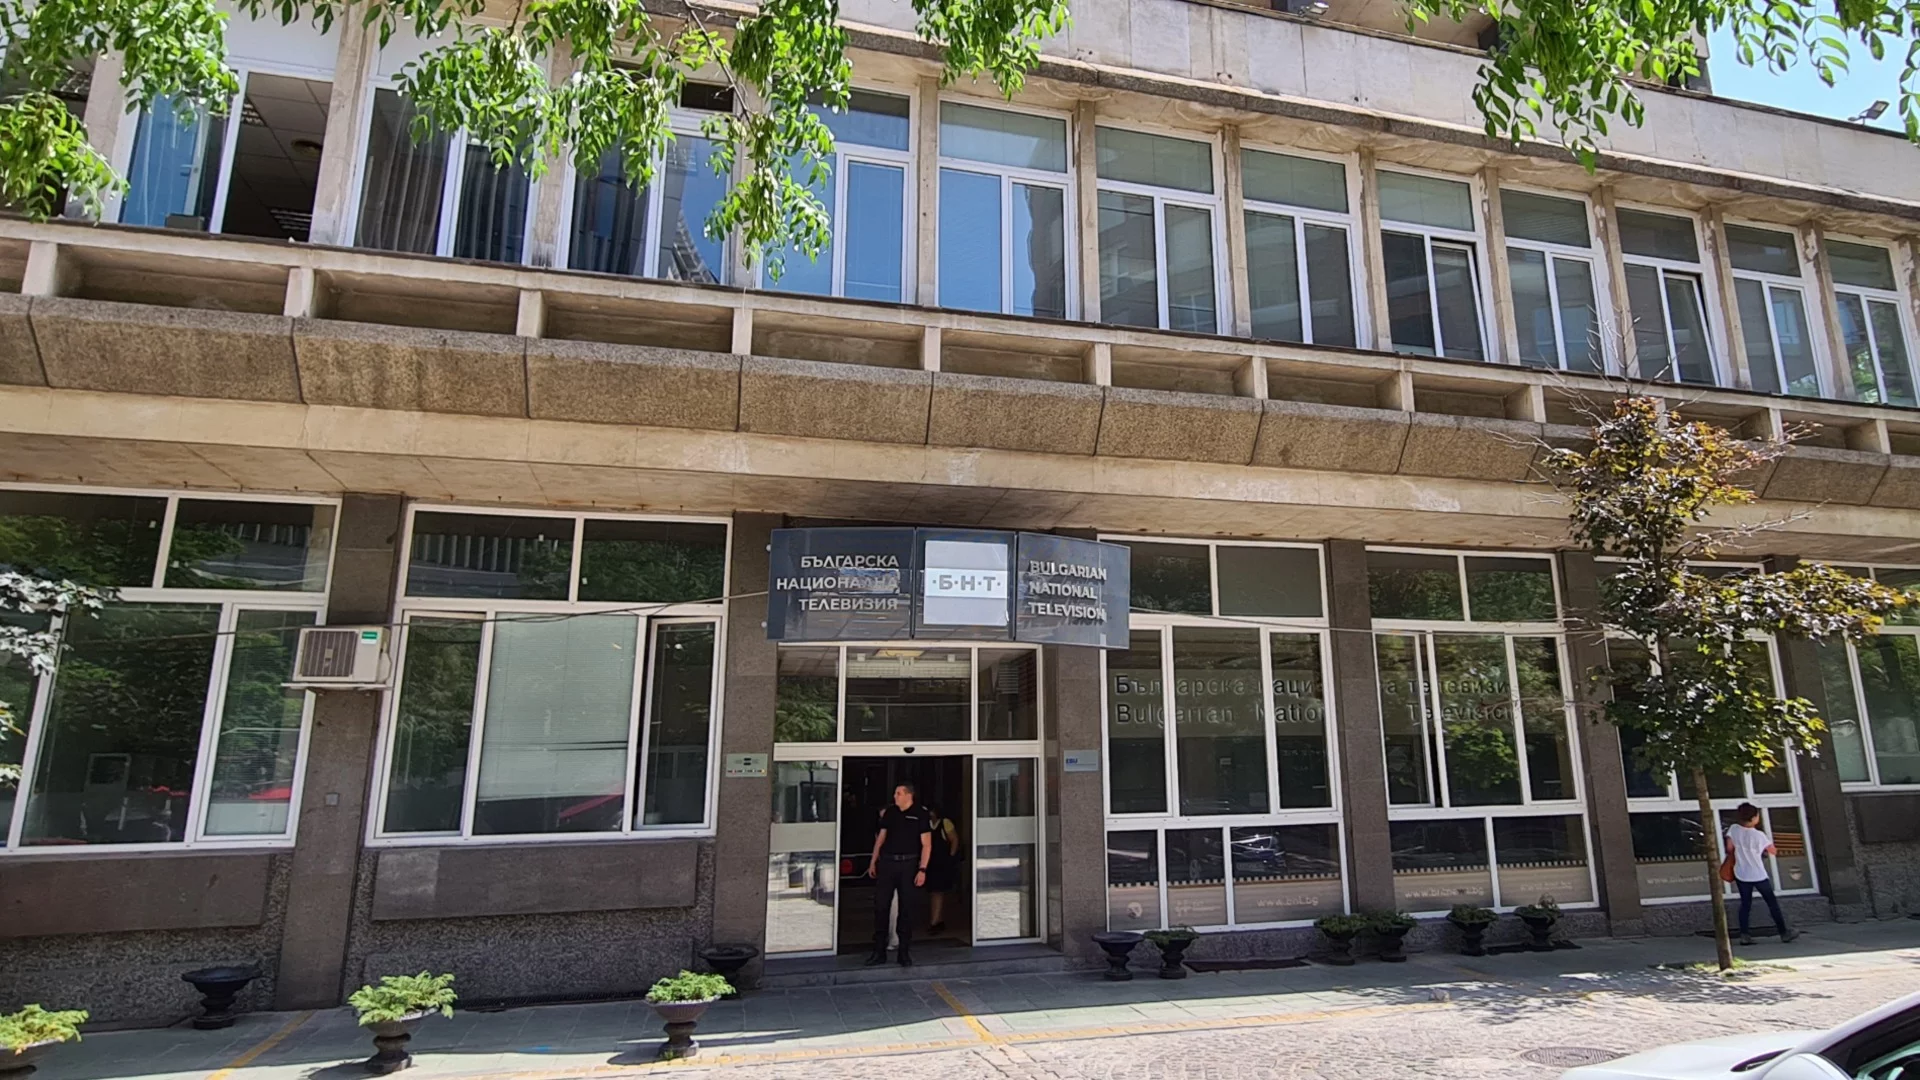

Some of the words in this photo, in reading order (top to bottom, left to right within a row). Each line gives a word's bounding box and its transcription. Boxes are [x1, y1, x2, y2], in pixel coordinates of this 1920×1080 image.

[800, 555, 899, 568] БЪЛГАРСКА
[1029, 560, 1107, 580] BULGARIAN
[776, 576, 898, 591] НАЦИОНАЛНА
[1029, 581, 1097, 599] NATIONAL
[799, 597, 898, 611] ТЕЛЕВИЗИЯ
[1028, 601, 1107, 622] TELEVISION
[1114, 674, 1246, 698] Бъларска
